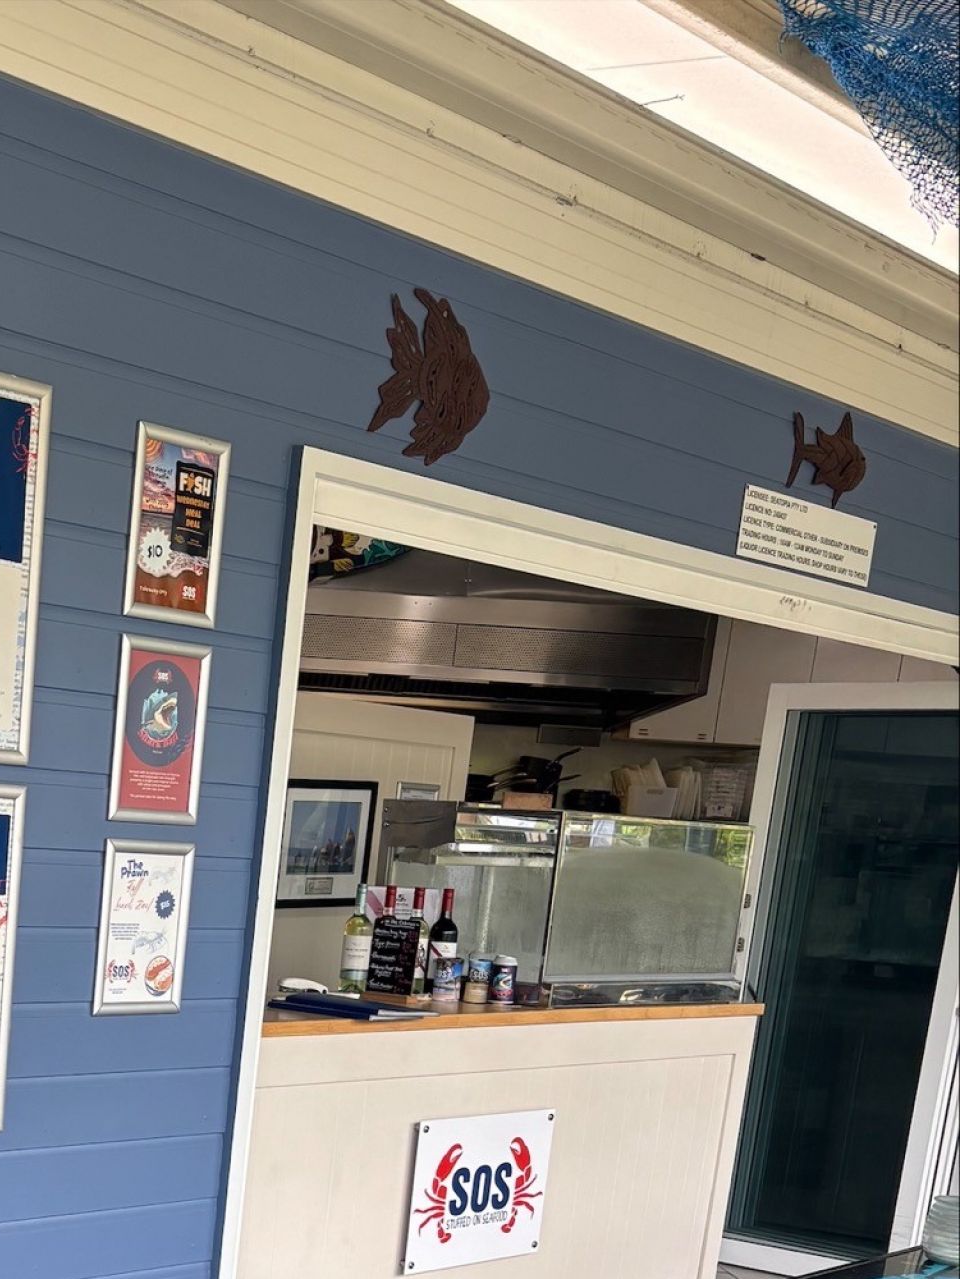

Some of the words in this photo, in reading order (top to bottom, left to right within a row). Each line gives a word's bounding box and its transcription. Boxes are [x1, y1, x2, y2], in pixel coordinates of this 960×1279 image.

[179, 471, 212, 497] FISH
[745, 502, 764, 514] LICENCE
[743, 515, 762, 527] LICENCE
[147, 544, 163, 558] $10
[127, 859, 143, 870] The
[121, 866, 149, 879] Prawn
[112, 964, 130, 978] SOS
[449, 1162, 512, 1217] SOS
[446, 1215, 471, 1230] STUFFED
[472, 1214, 481, 1226] ON
[482, 1210, 508, 1225] SEAFOOD
